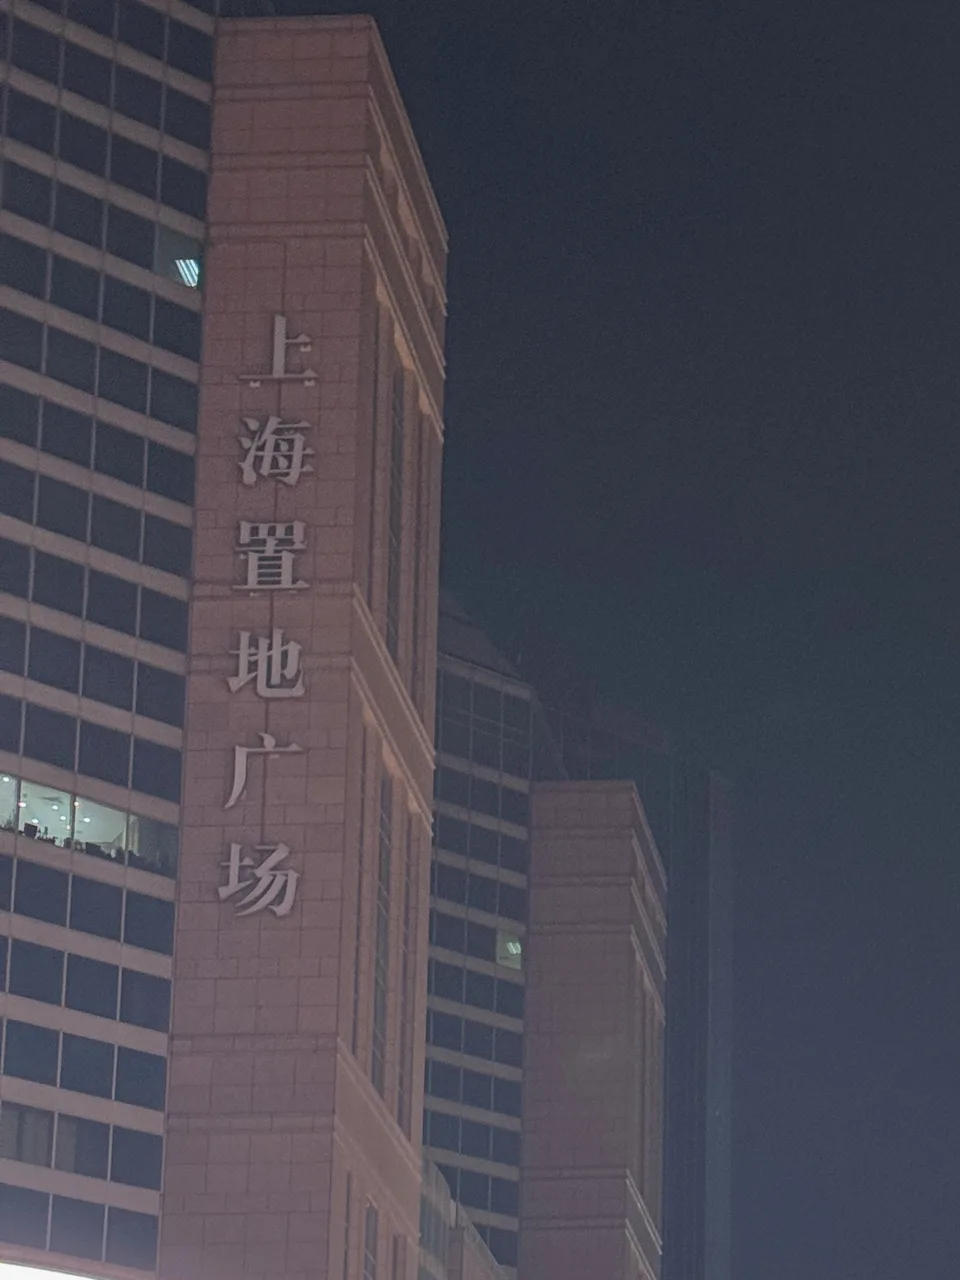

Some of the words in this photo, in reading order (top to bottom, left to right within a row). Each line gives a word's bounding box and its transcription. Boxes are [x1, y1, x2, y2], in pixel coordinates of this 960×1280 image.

[218, 314, 319, 917] 上海置地广场
